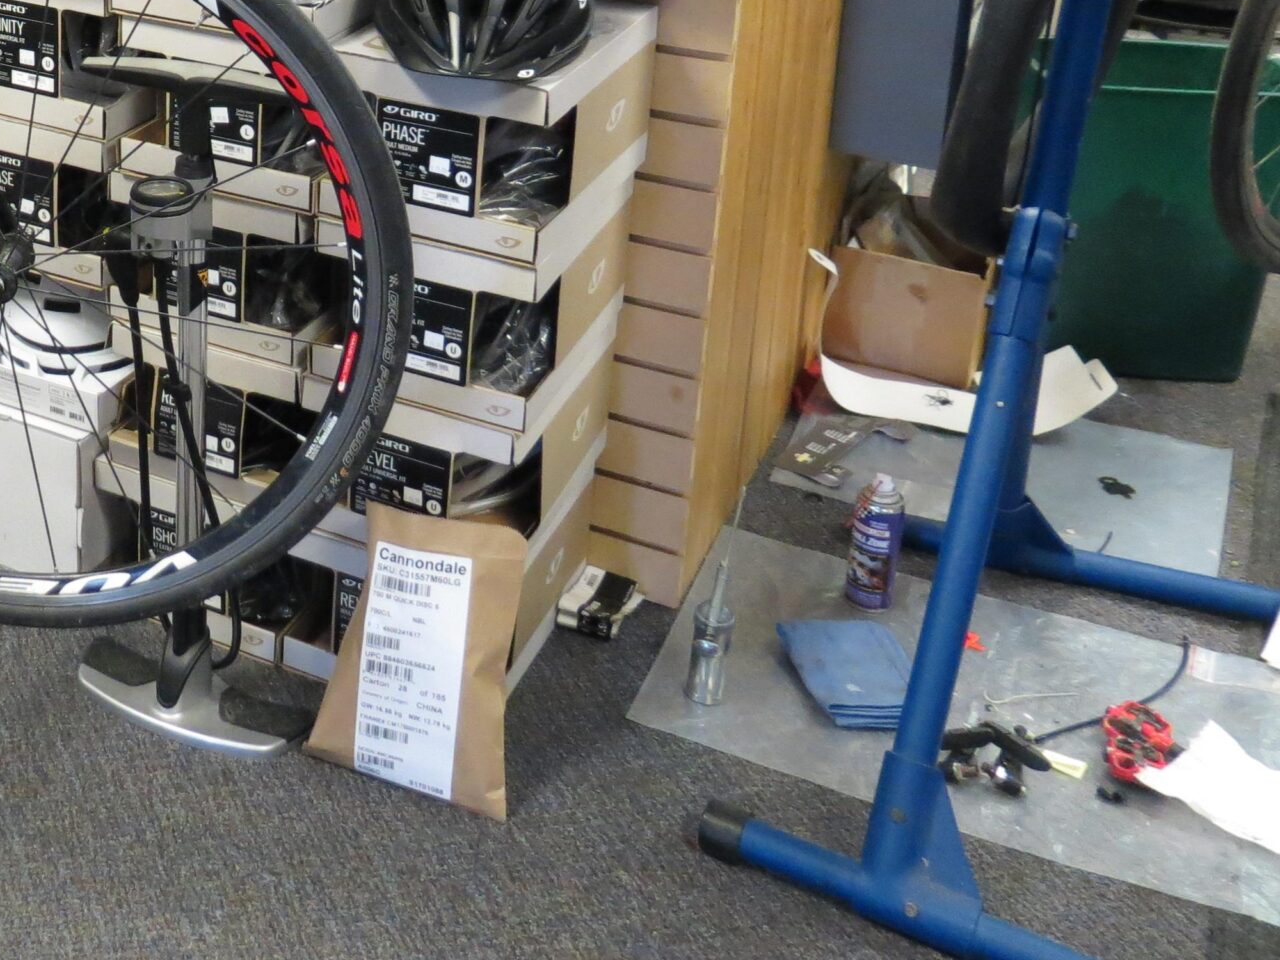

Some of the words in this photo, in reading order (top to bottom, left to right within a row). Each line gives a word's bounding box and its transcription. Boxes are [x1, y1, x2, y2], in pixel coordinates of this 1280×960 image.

[399, 107, 437, 122] GIRO
[382, 121, 426, 146] PHASE
[350, 247, 364, 326] Lite
[377, 562, 398, 574] SKU:
[379, 547, 467, 575] Cannondale
[365, 651, 381, 660] UPC
[362, 676, 390, 689] Carton
[416, 702, 444, 715] CHINA
